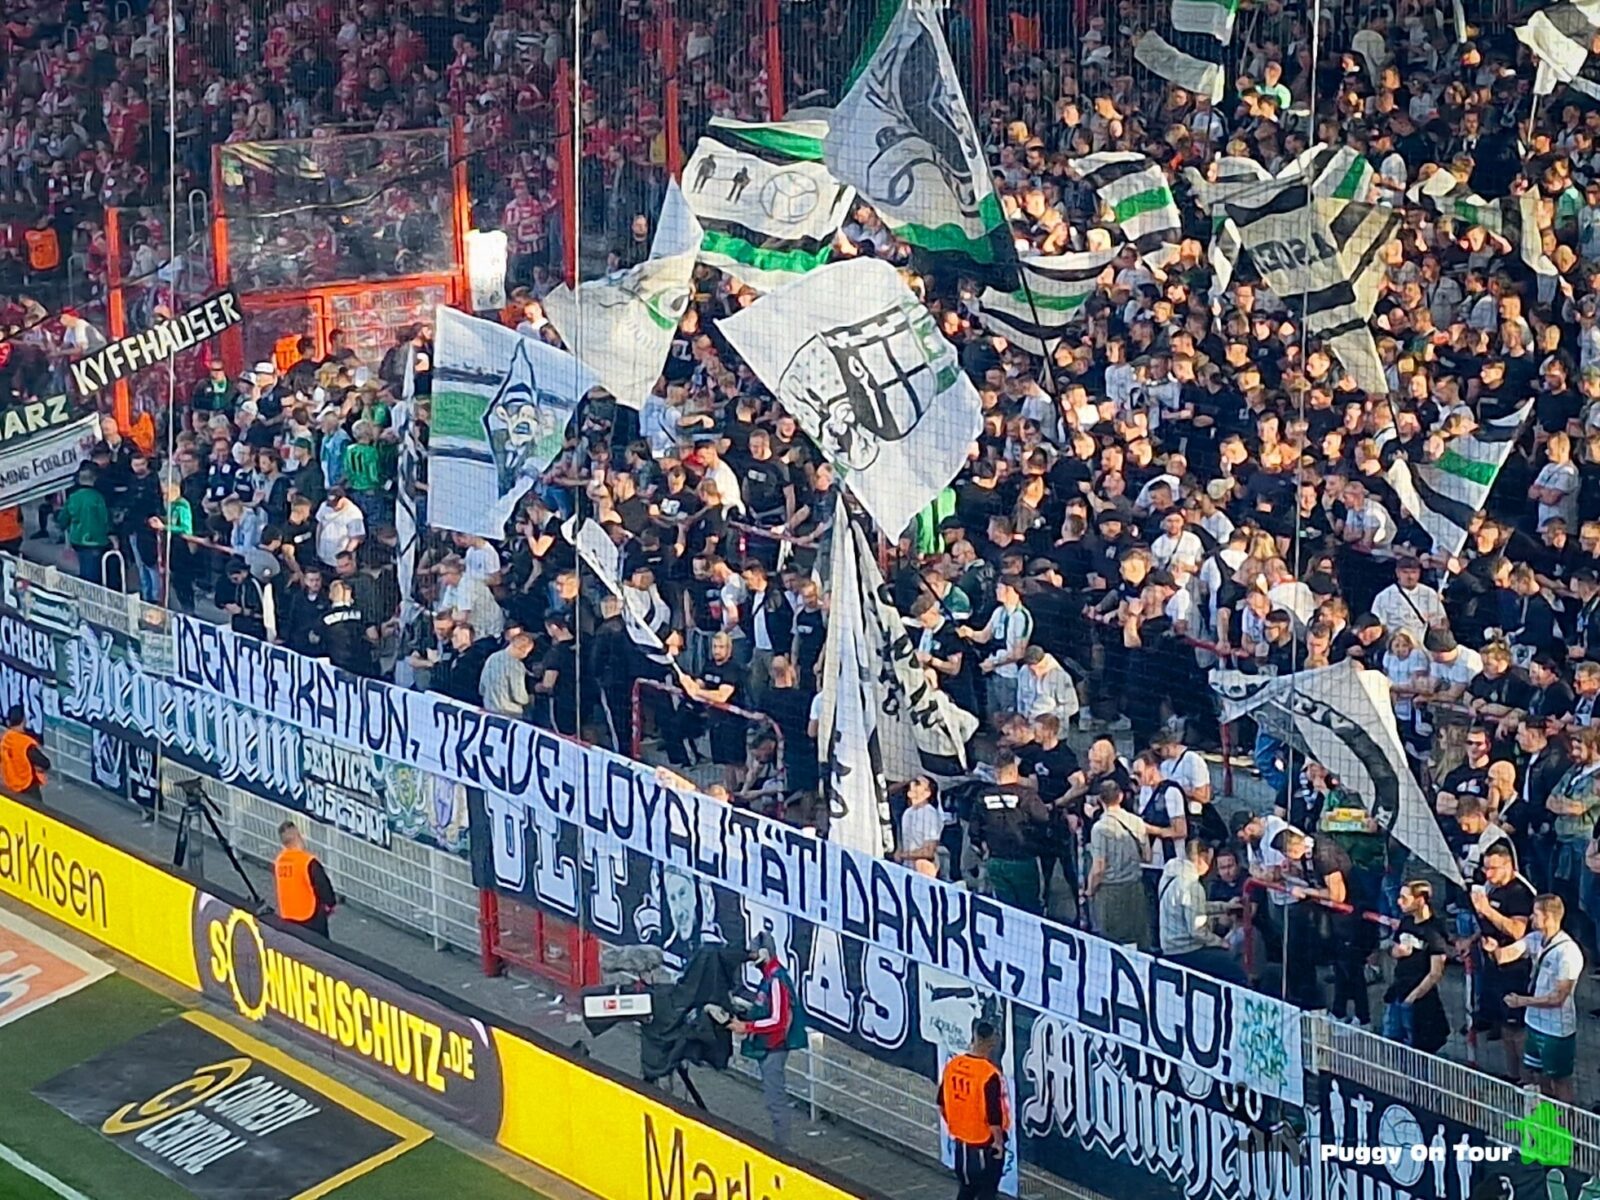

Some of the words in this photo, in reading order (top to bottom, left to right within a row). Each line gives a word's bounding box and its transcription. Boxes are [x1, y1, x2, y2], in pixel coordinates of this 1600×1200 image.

[71, 292, 241, 396] KYFFHÄUSER
[0, 394, 69, 440] ARZ
[176, 614, 420, 762] IDENTIFIKATION,
[434, 702, 575, 814] TREUE,
[583, 753, 828, 921] LOYALITÄT!
[841, 849, 1026, 999] DANKE,
[1040, 923, 1233, 1076] FLACO!
[204, 1075, 321, 1136] COMEDY
[135, 1109, 247, 1175] CENTRAL
